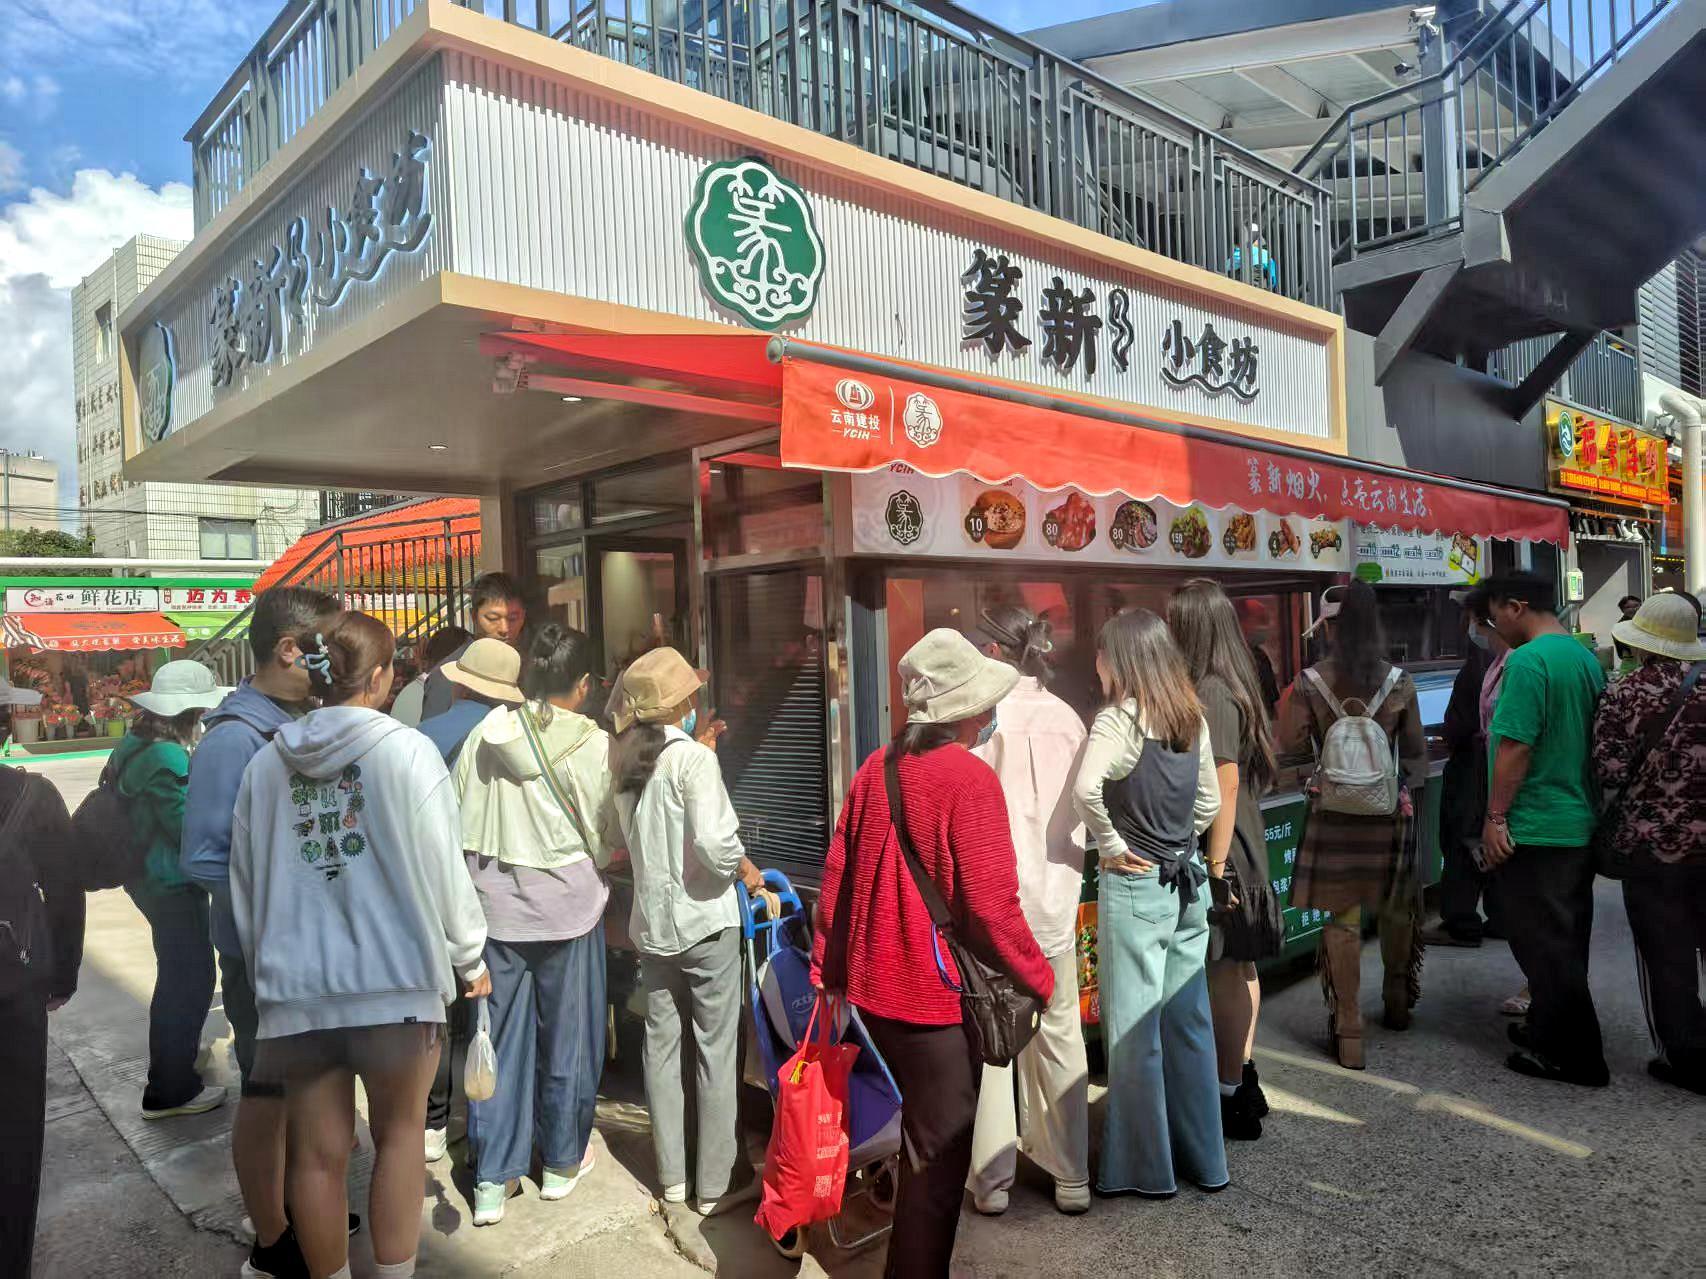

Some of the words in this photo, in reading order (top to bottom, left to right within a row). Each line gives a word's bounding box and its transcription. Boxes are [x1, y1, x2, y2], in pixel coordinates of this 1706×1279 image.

[960, 247, 1104, 376] 篆新
[1161, 318, 1260, 387] 小食坊
[830, 408, 881, 432] 云南建投
[843, 427, 871, 440] YCIH
[969, 517, 983, 532] 10
[1045, 523, 1059, 536] 80
[1112, 527, 1124, 540] 80
[1171, 532, 1183, 543] 150
[81, 588, 142, 606] 鲜花店
[1264, 822, 1292, 841] 55元/斤
[1271, 875, 1292, 895] 包浆
